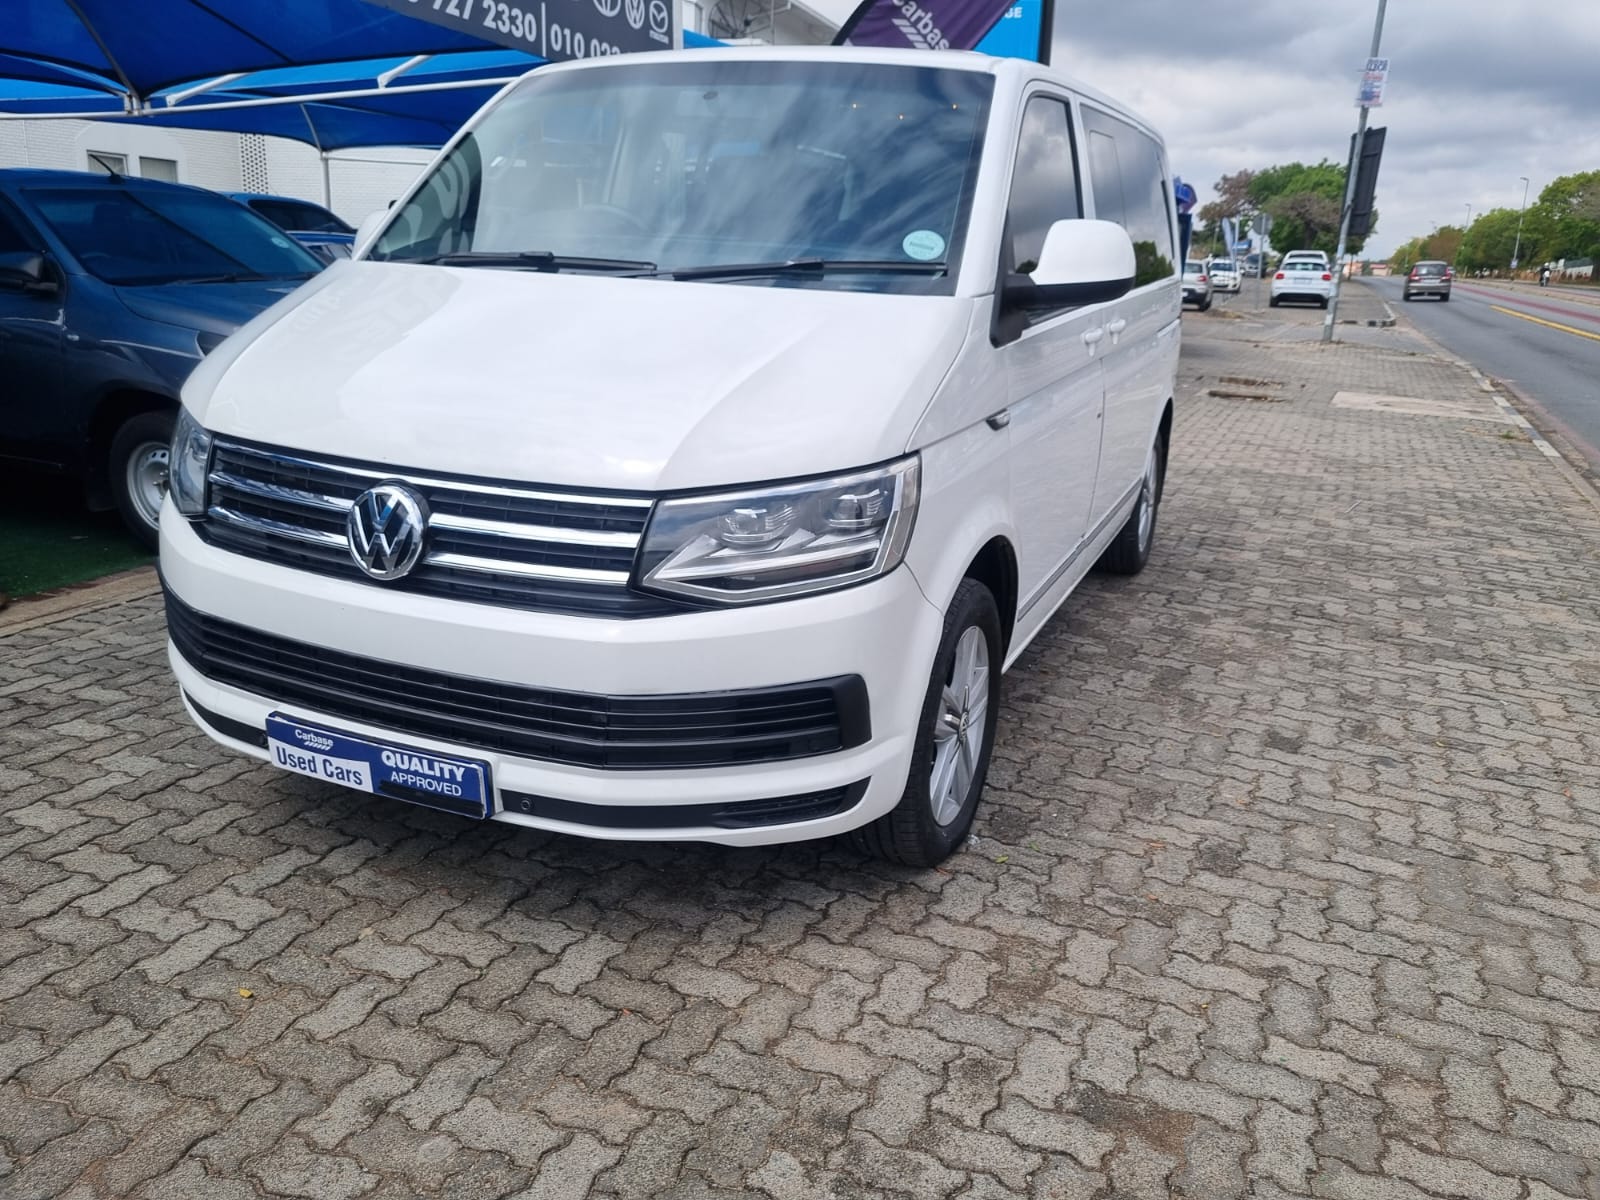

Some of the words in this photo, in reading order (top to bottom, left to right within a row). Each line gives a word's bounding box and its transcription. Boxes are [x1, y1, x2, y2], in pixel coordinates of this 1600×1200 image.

[482, 0, 537, 42] 2330
[550, 23, 585, 59] 010
[294, 729, 334, 748] Carbase
[276, 745, 318, 774] Used
[322, 757, 363, 786] Cars
[381, 750, 466, 782] QUALITY
[390, 771, 463, 797] APPROVED
